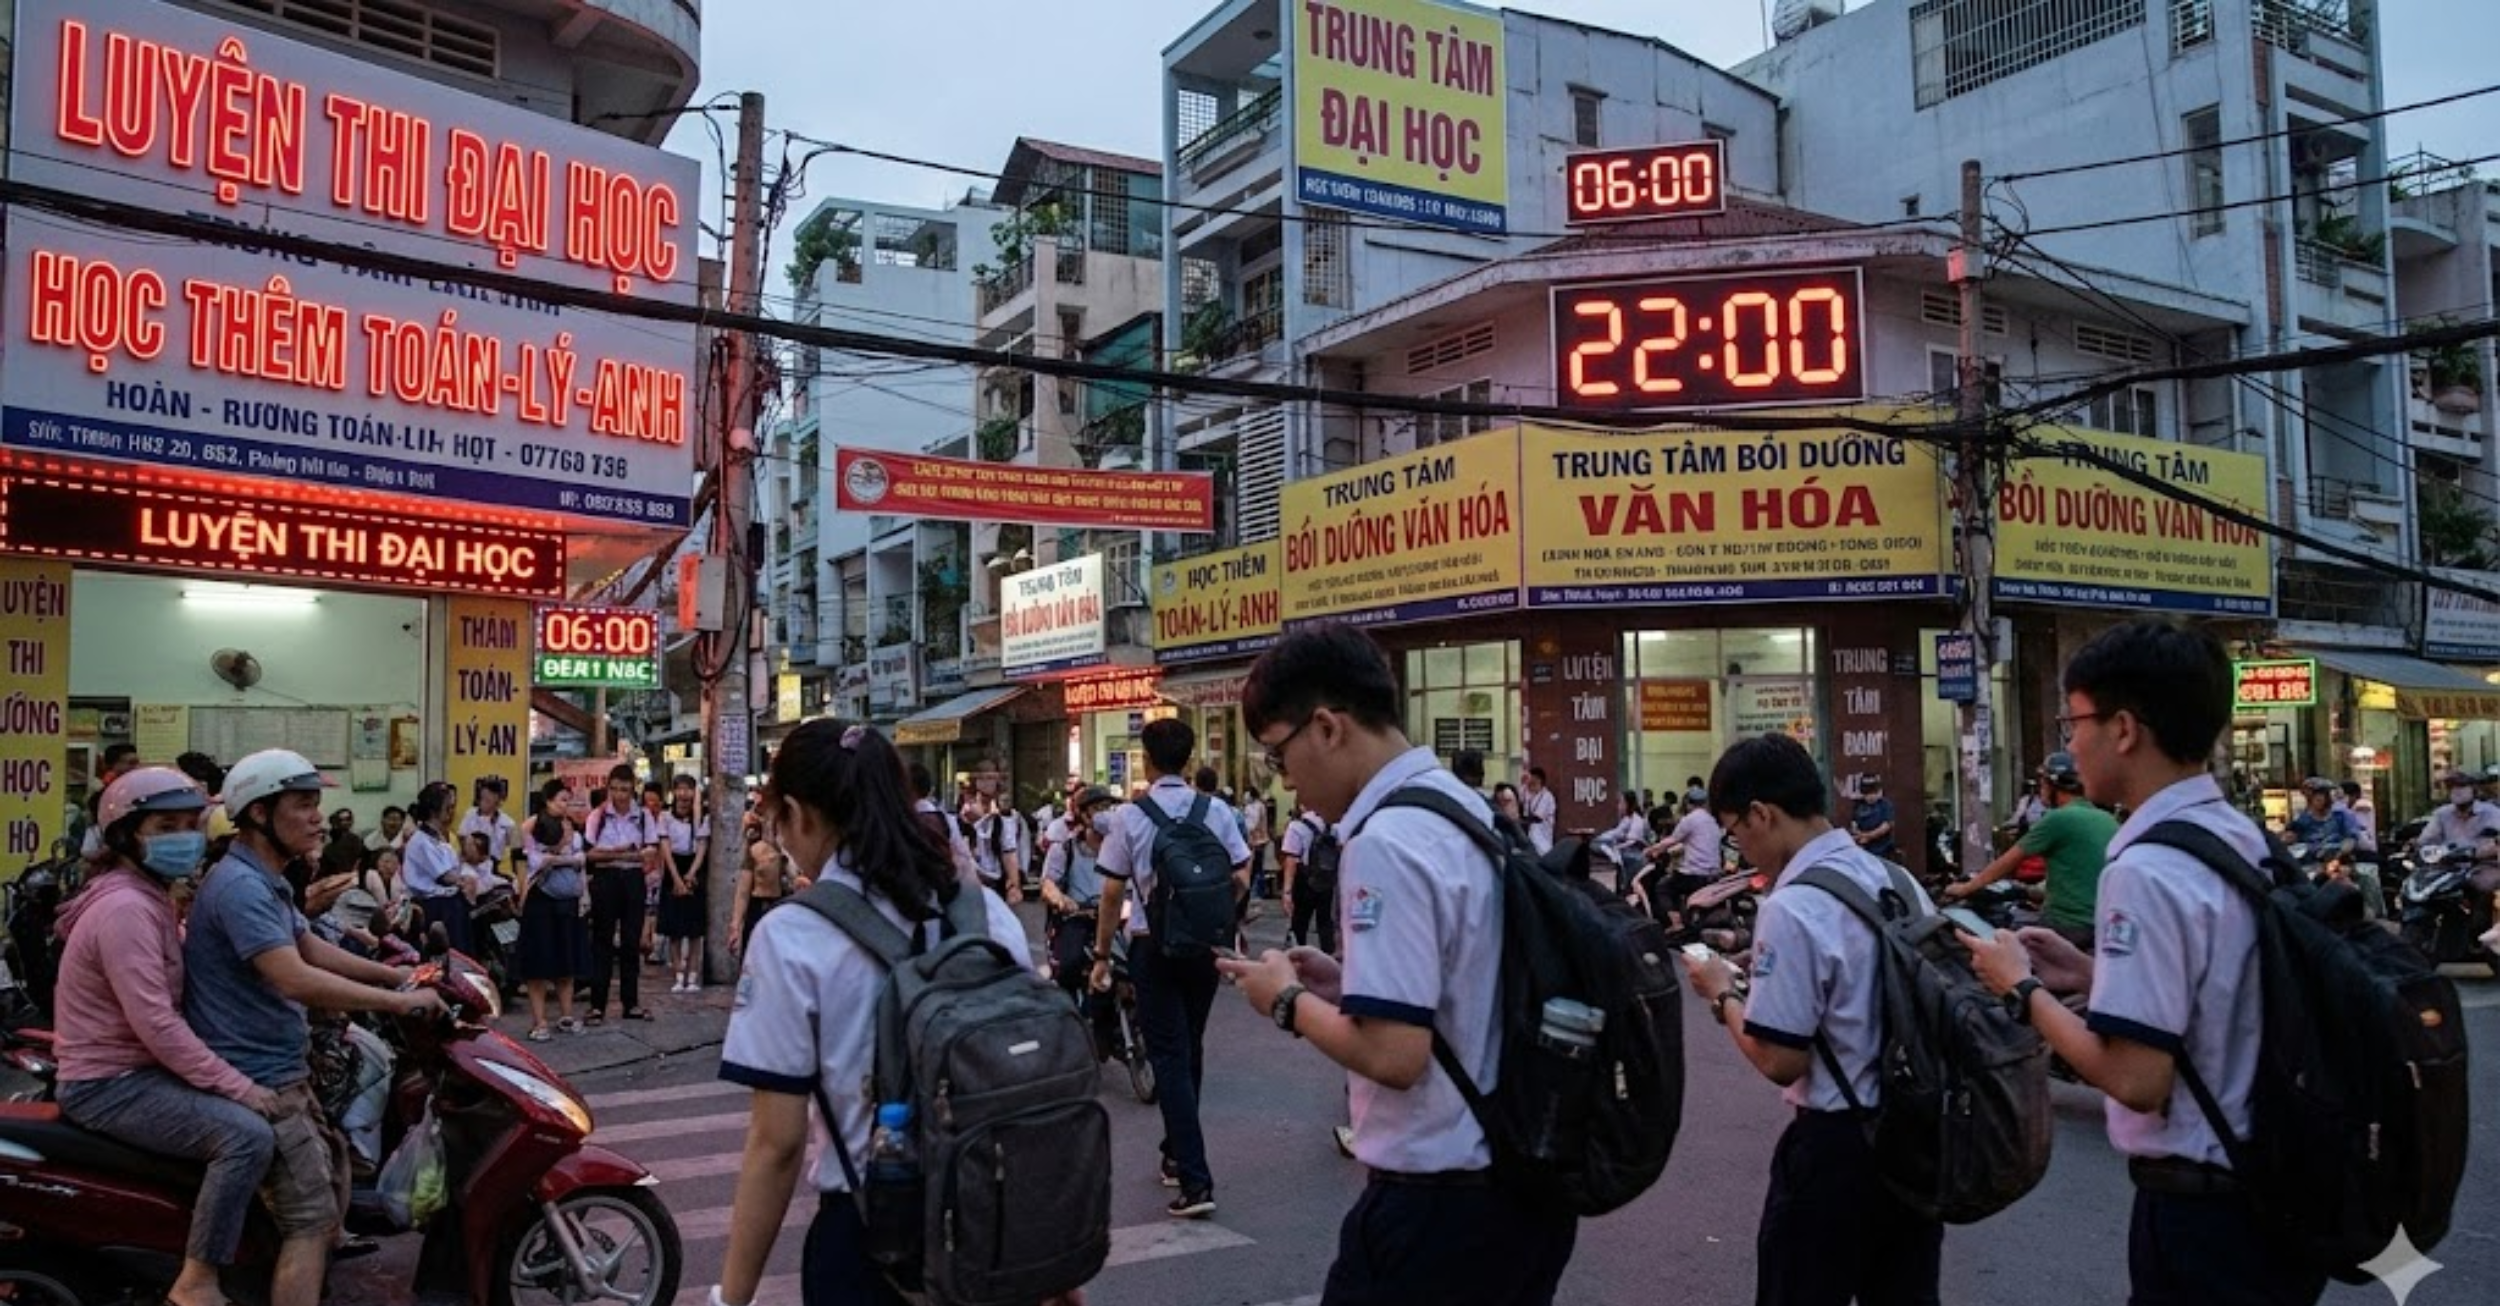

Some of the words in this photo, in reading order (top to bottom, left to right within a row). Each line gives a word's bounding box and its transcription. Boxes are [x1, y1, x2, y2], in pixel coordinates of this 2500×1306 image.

[1306, 0, 1415, 78] TRUNG
[58, 20, 307, 204] LUYỆN
[325, 93, 430, 224] THI
[446, 127, 550, 268] ĐẠI
[566, 161, 679, 294] HỌC
[1320, 87, 1389, 166] ĐẠI
[1404, 105, 1480, 182] HỌC
[1574, 152, 1713, 212] 06:00
[30, 250, 166, 372] HỌC
[185, 274, 347, 390] THÊM
[363, 308, 686, 447] TOÁN-LÝ-ANH
[1569, 287, 1846, 397] 22:00
[1323, 470, 1395, 508] TRUNG
[1552, 448, 1652, 480] TRUNG
[1662, 438, 1727, 476] TÂM
[2156, 451, 2210, 484] TÂM
[1579, 482, 1716, 537] VĂN
[1742, 474, 1882, 532] HÓA
[139, 508, 289, 561] LUYỆN
[300, 525, 368, 564] THI
[379, 533, 446, 579] ĐẠI
[457, 545, 538, 583] HỌC
[1222, 552, 1266, 582] THÊM
[9, 639, 44, 675] THI
[546, 613, 651, 652] 06:00
[3, 759, 51, 803] HỌC
